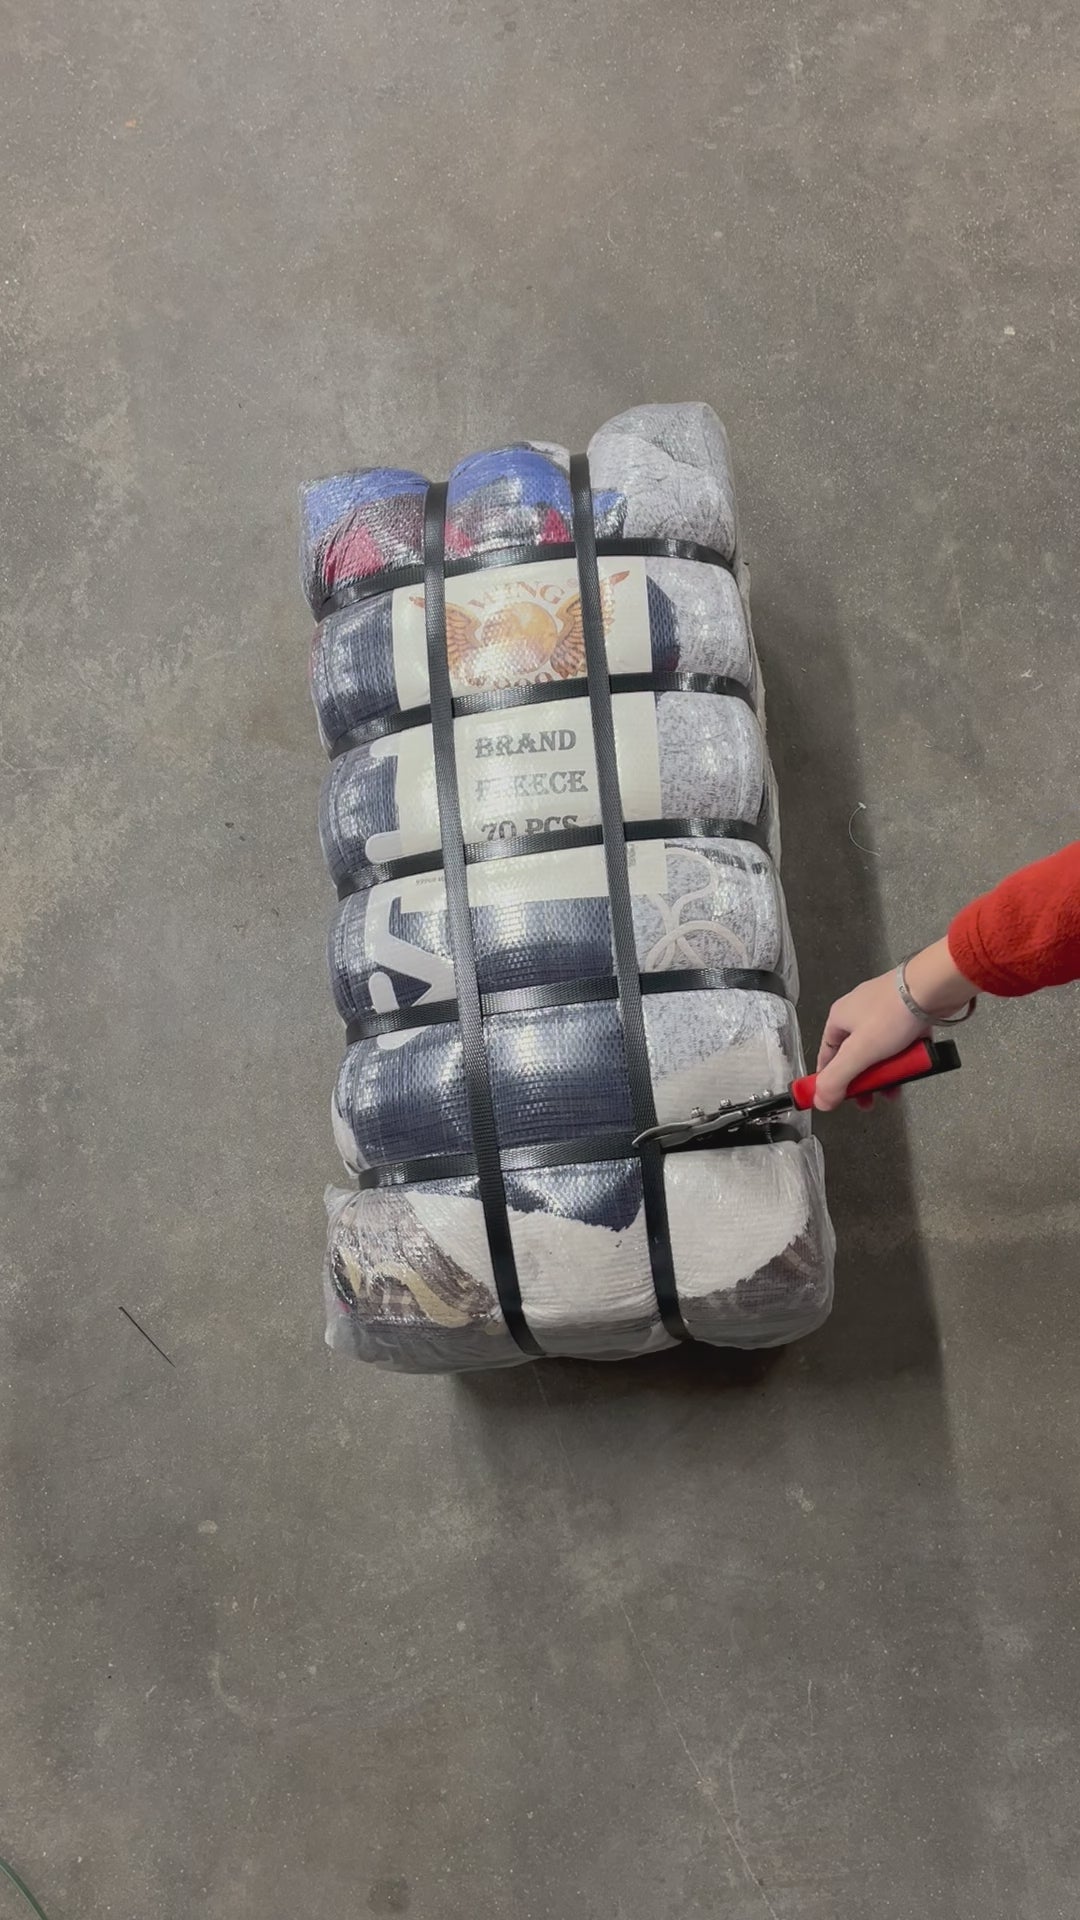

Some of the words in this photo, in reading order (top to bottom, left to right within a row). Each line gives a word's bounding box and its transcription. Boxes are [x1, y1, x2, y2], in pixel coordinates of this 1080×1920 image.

[475, 729, 577, 758] BRAND
[475, 770, 589, 802] FEECE
[481, 820, 518, 841] 70
[525, 815, 580, 836] PCS
